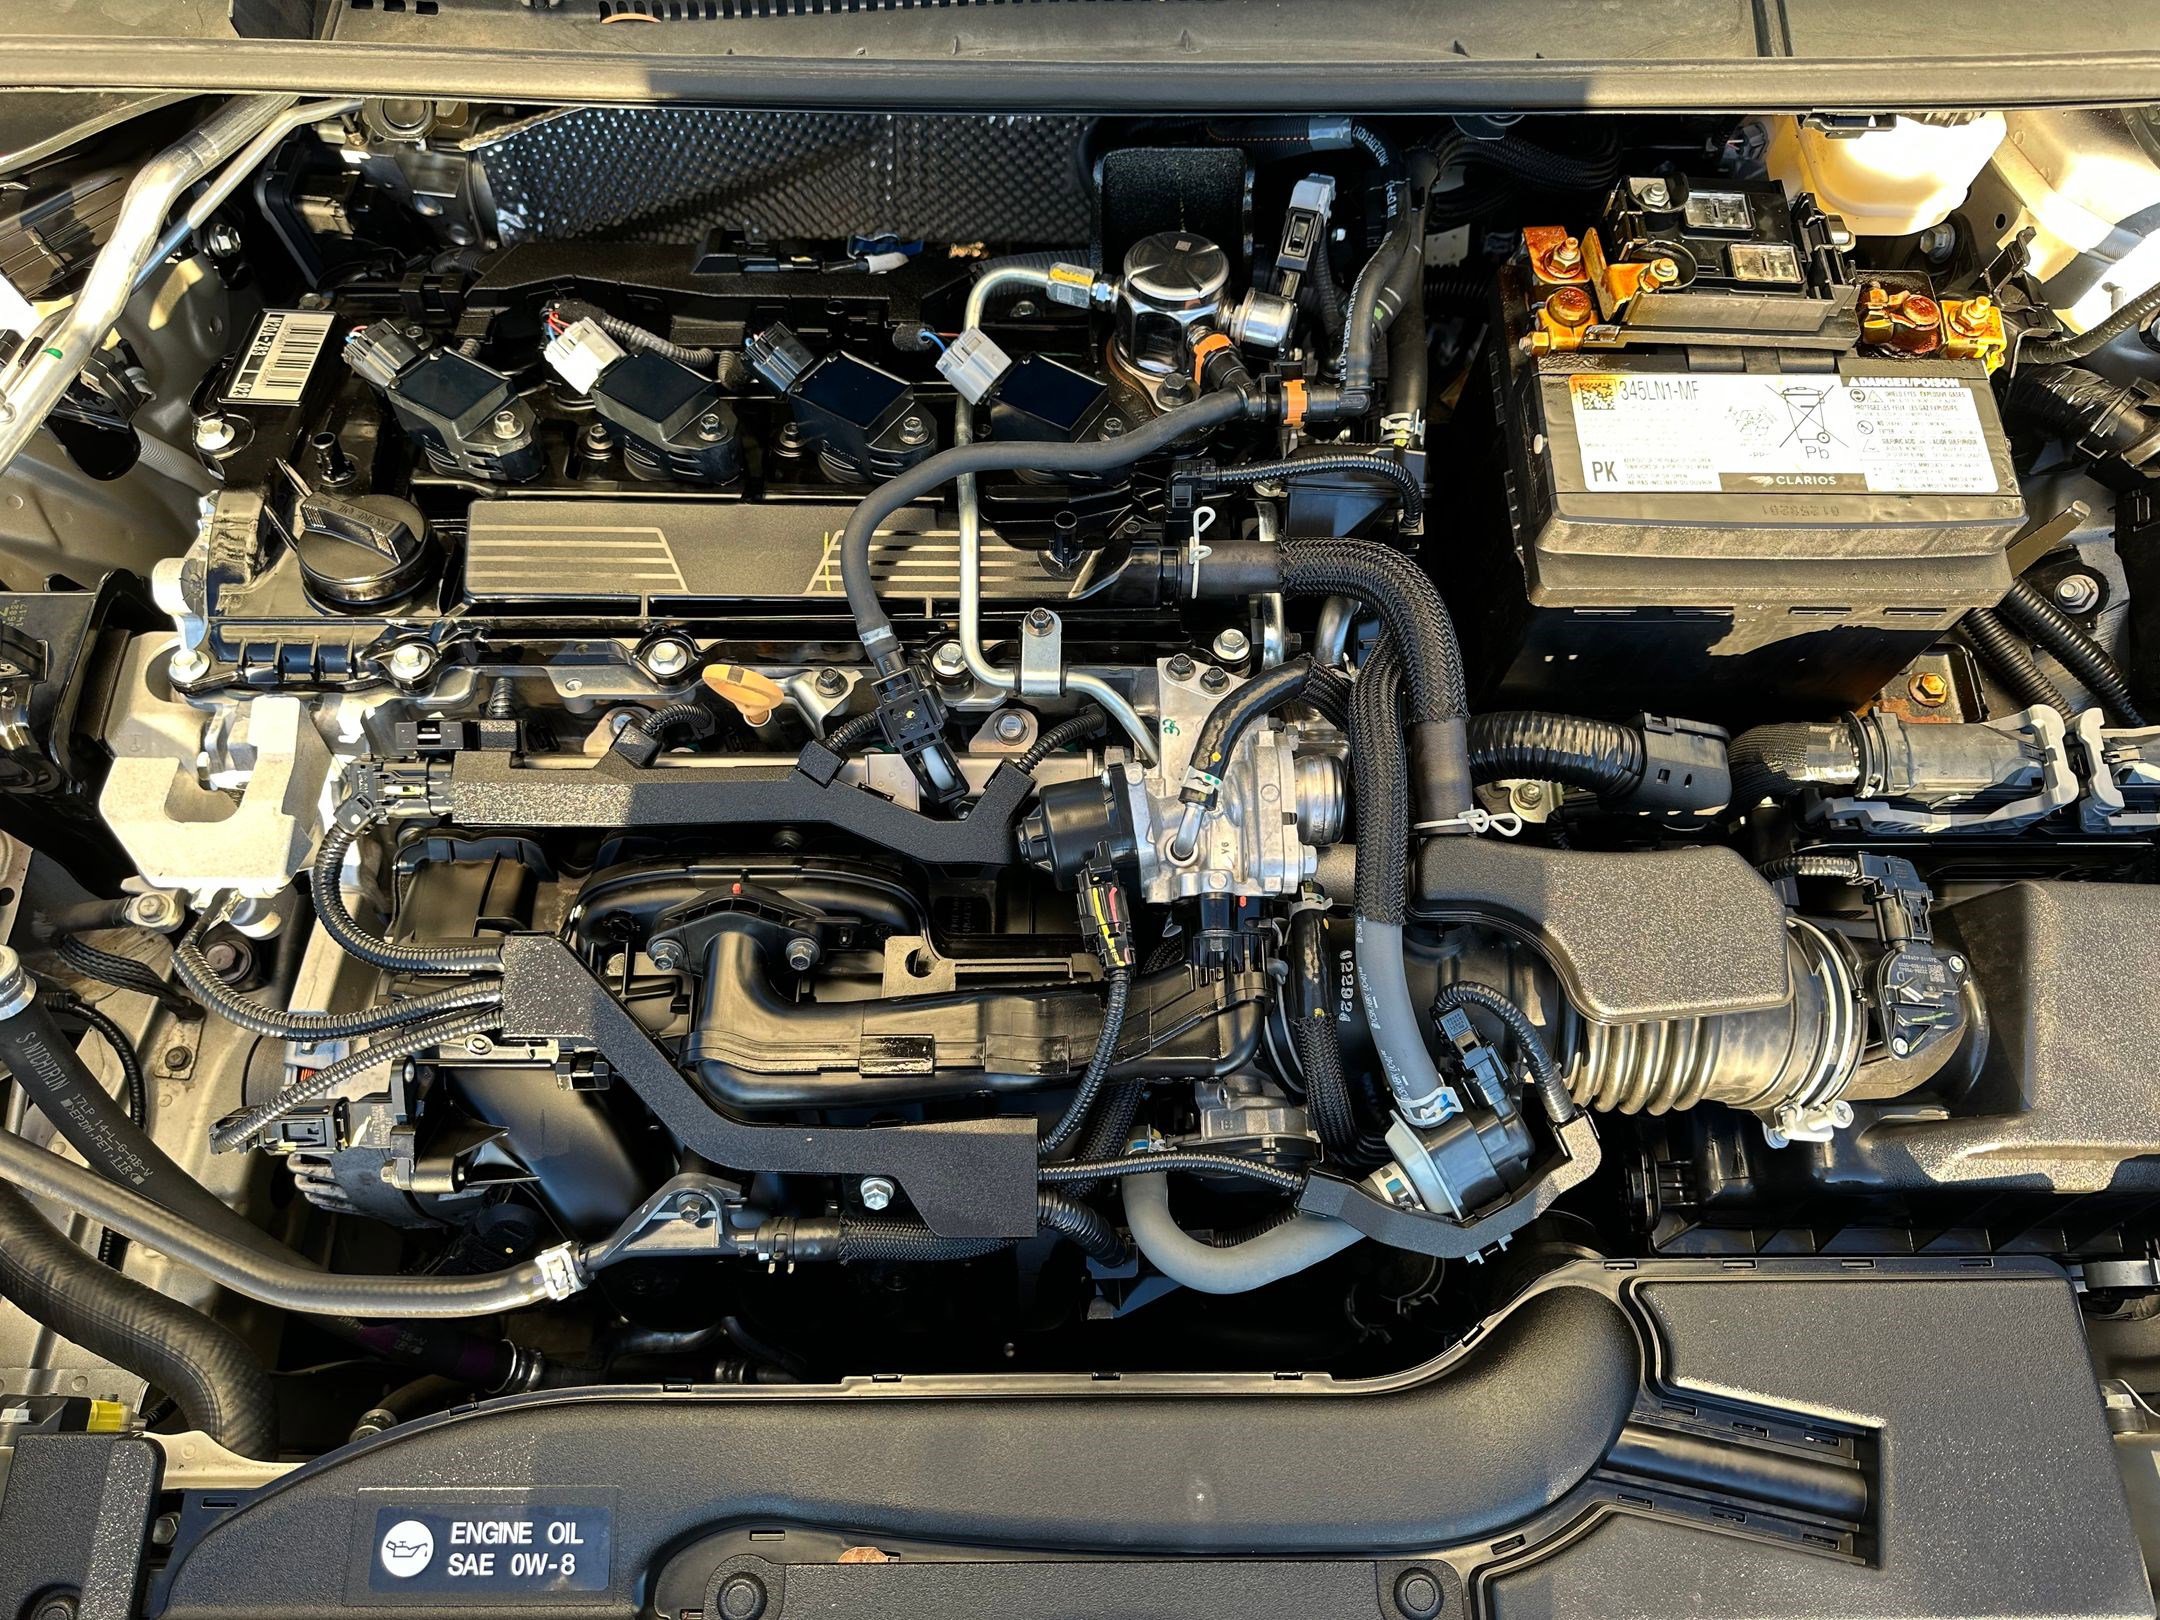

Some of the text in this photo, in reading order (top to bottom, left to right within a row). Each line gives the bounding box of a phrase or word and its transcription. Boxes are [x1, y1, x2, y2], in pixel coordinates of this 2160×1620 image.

[1619, 380, 1700, 400] 345LN1-MF
[1859, 377, 1960, 388] DANGER/POISON
[1805, 445, 1830, 459] Pb
[1591, 461, 1619, 482] PK
[1775, 475, 1837, 485] CLARIOS
[72, 1093, 96, 1116] 17LP
[450, 1521, 585, 1545] ENGINE OIL
[447, 1553, 577, 1576] SAE 0W-8
